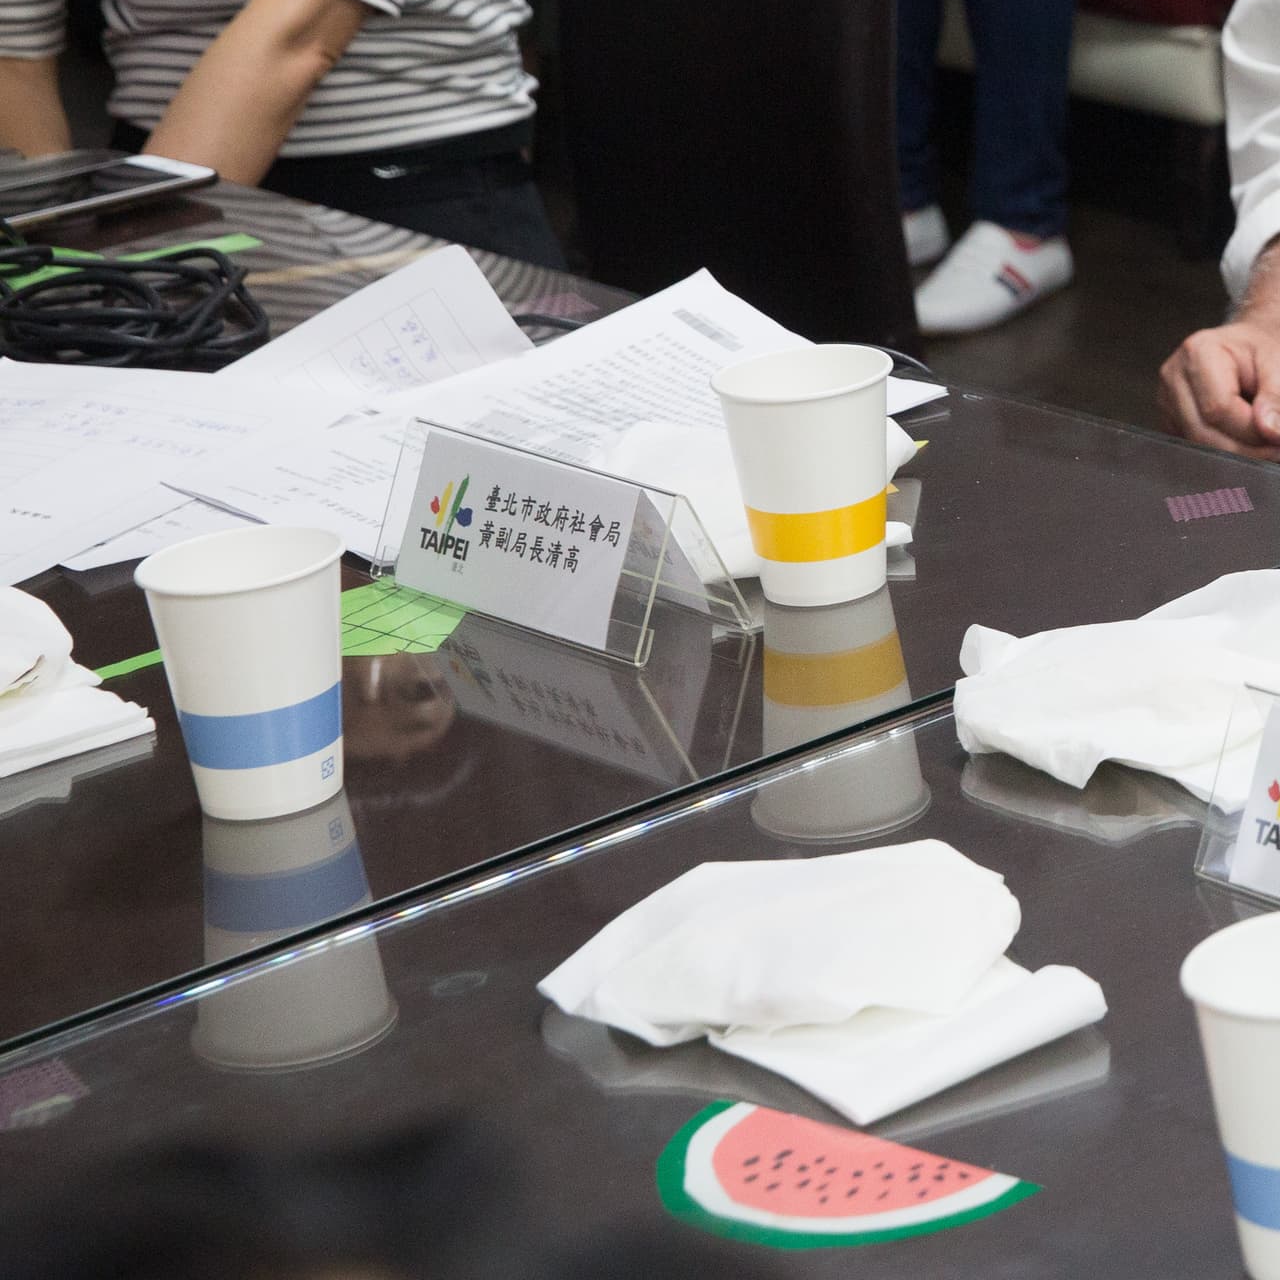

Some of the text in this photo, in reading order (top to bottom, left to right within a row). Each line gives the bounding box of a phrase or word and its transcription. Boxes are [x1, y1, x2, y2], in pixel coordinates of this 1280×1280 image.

[485, 484, 621, 548] 臺北市政府社會局
[420, 527, 470, 561] TAIPEI
[478, 520, 580, 574] 黃副局長清高
